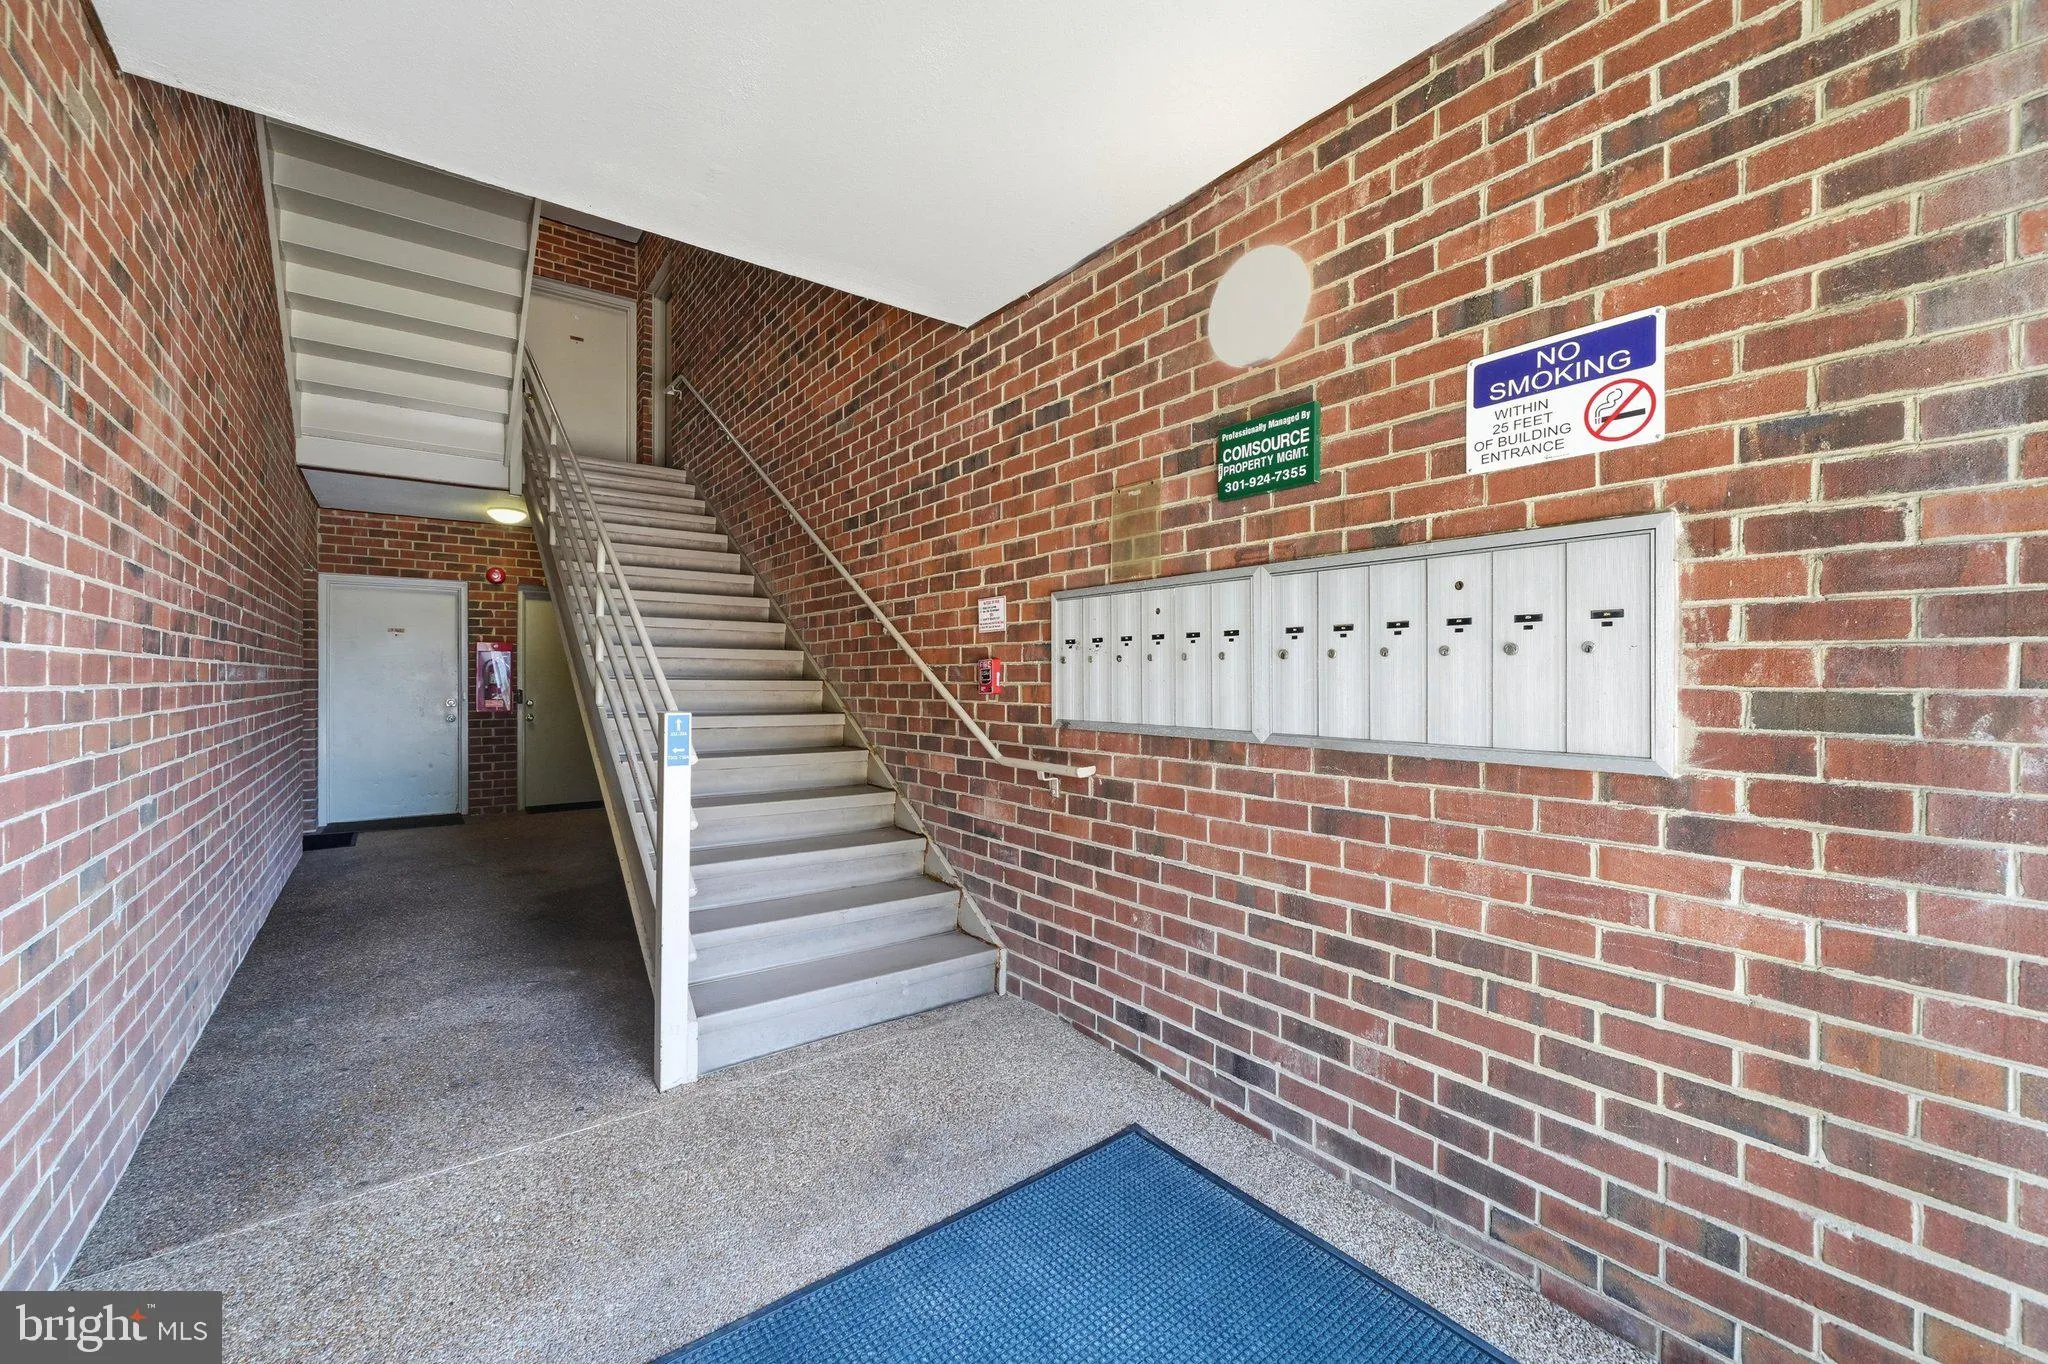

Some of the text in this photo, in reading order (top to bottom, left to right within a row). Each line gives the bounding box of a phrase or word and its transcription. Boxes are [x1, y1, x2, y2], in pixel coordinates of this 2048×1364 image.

[1536, 341, 1580, 368] NO
[1489, 350, 1631, 401] SMOKING
[1492, 412, 1553, 435] 25 FEET
[1494, 398, 1549, 420] WITHIN
[1221, 410, 1311, 442] Professionally Managed By
[1473, 423, 1572, 453] OF BUILDING
[1222, 426, 1310, 463] COMSOURCE
[1481, 439, 1565, 464] ENTRANCE
[1223, 445, 1309, 477] PROPERTY MGMT.
[1224, 464, 1307, 493] 301-924-7355
